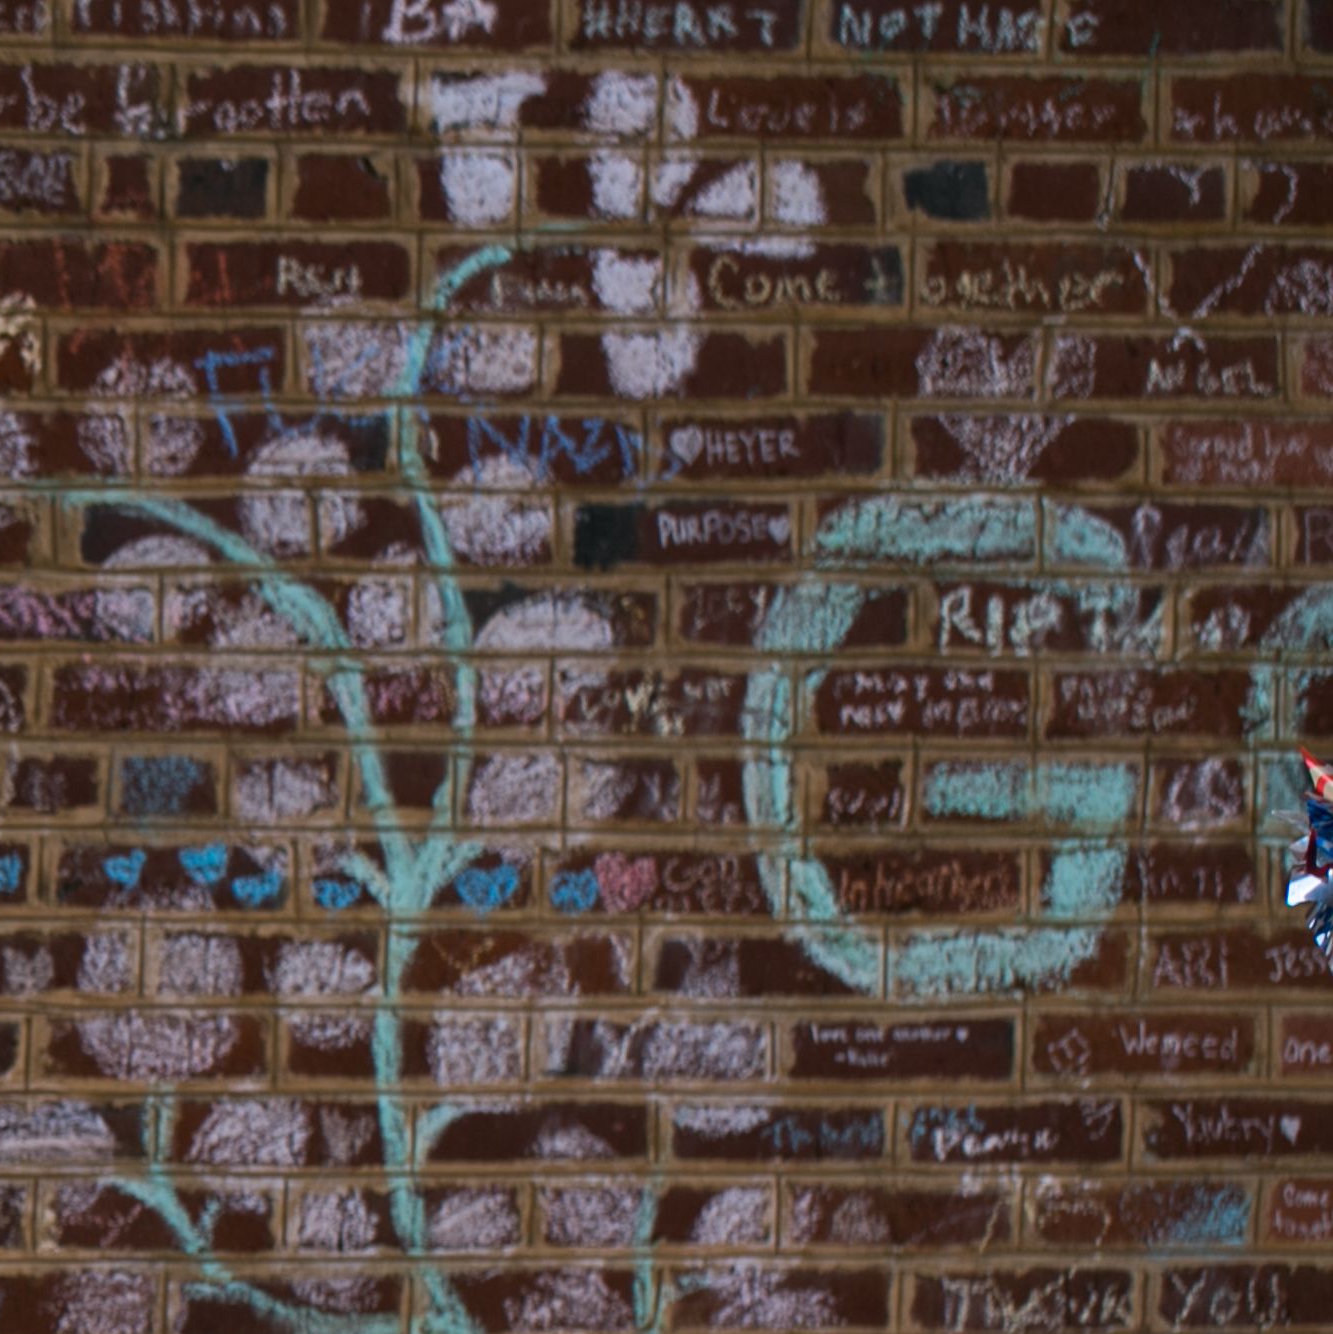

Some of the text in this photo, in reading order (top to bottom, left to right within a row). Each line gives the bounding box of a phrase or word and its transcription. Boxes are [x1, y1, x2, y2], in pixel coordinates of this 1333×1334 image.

[840, 4, 945, 46] NOT
[706, 254, 841, 310] Come
[704, 427, 800, 468] HEYER
[657, 510, 768, 550] PURPOSE
[938, 584, 1061, 658] RIP
[1170, 1270, 1284, 1334] YOU
